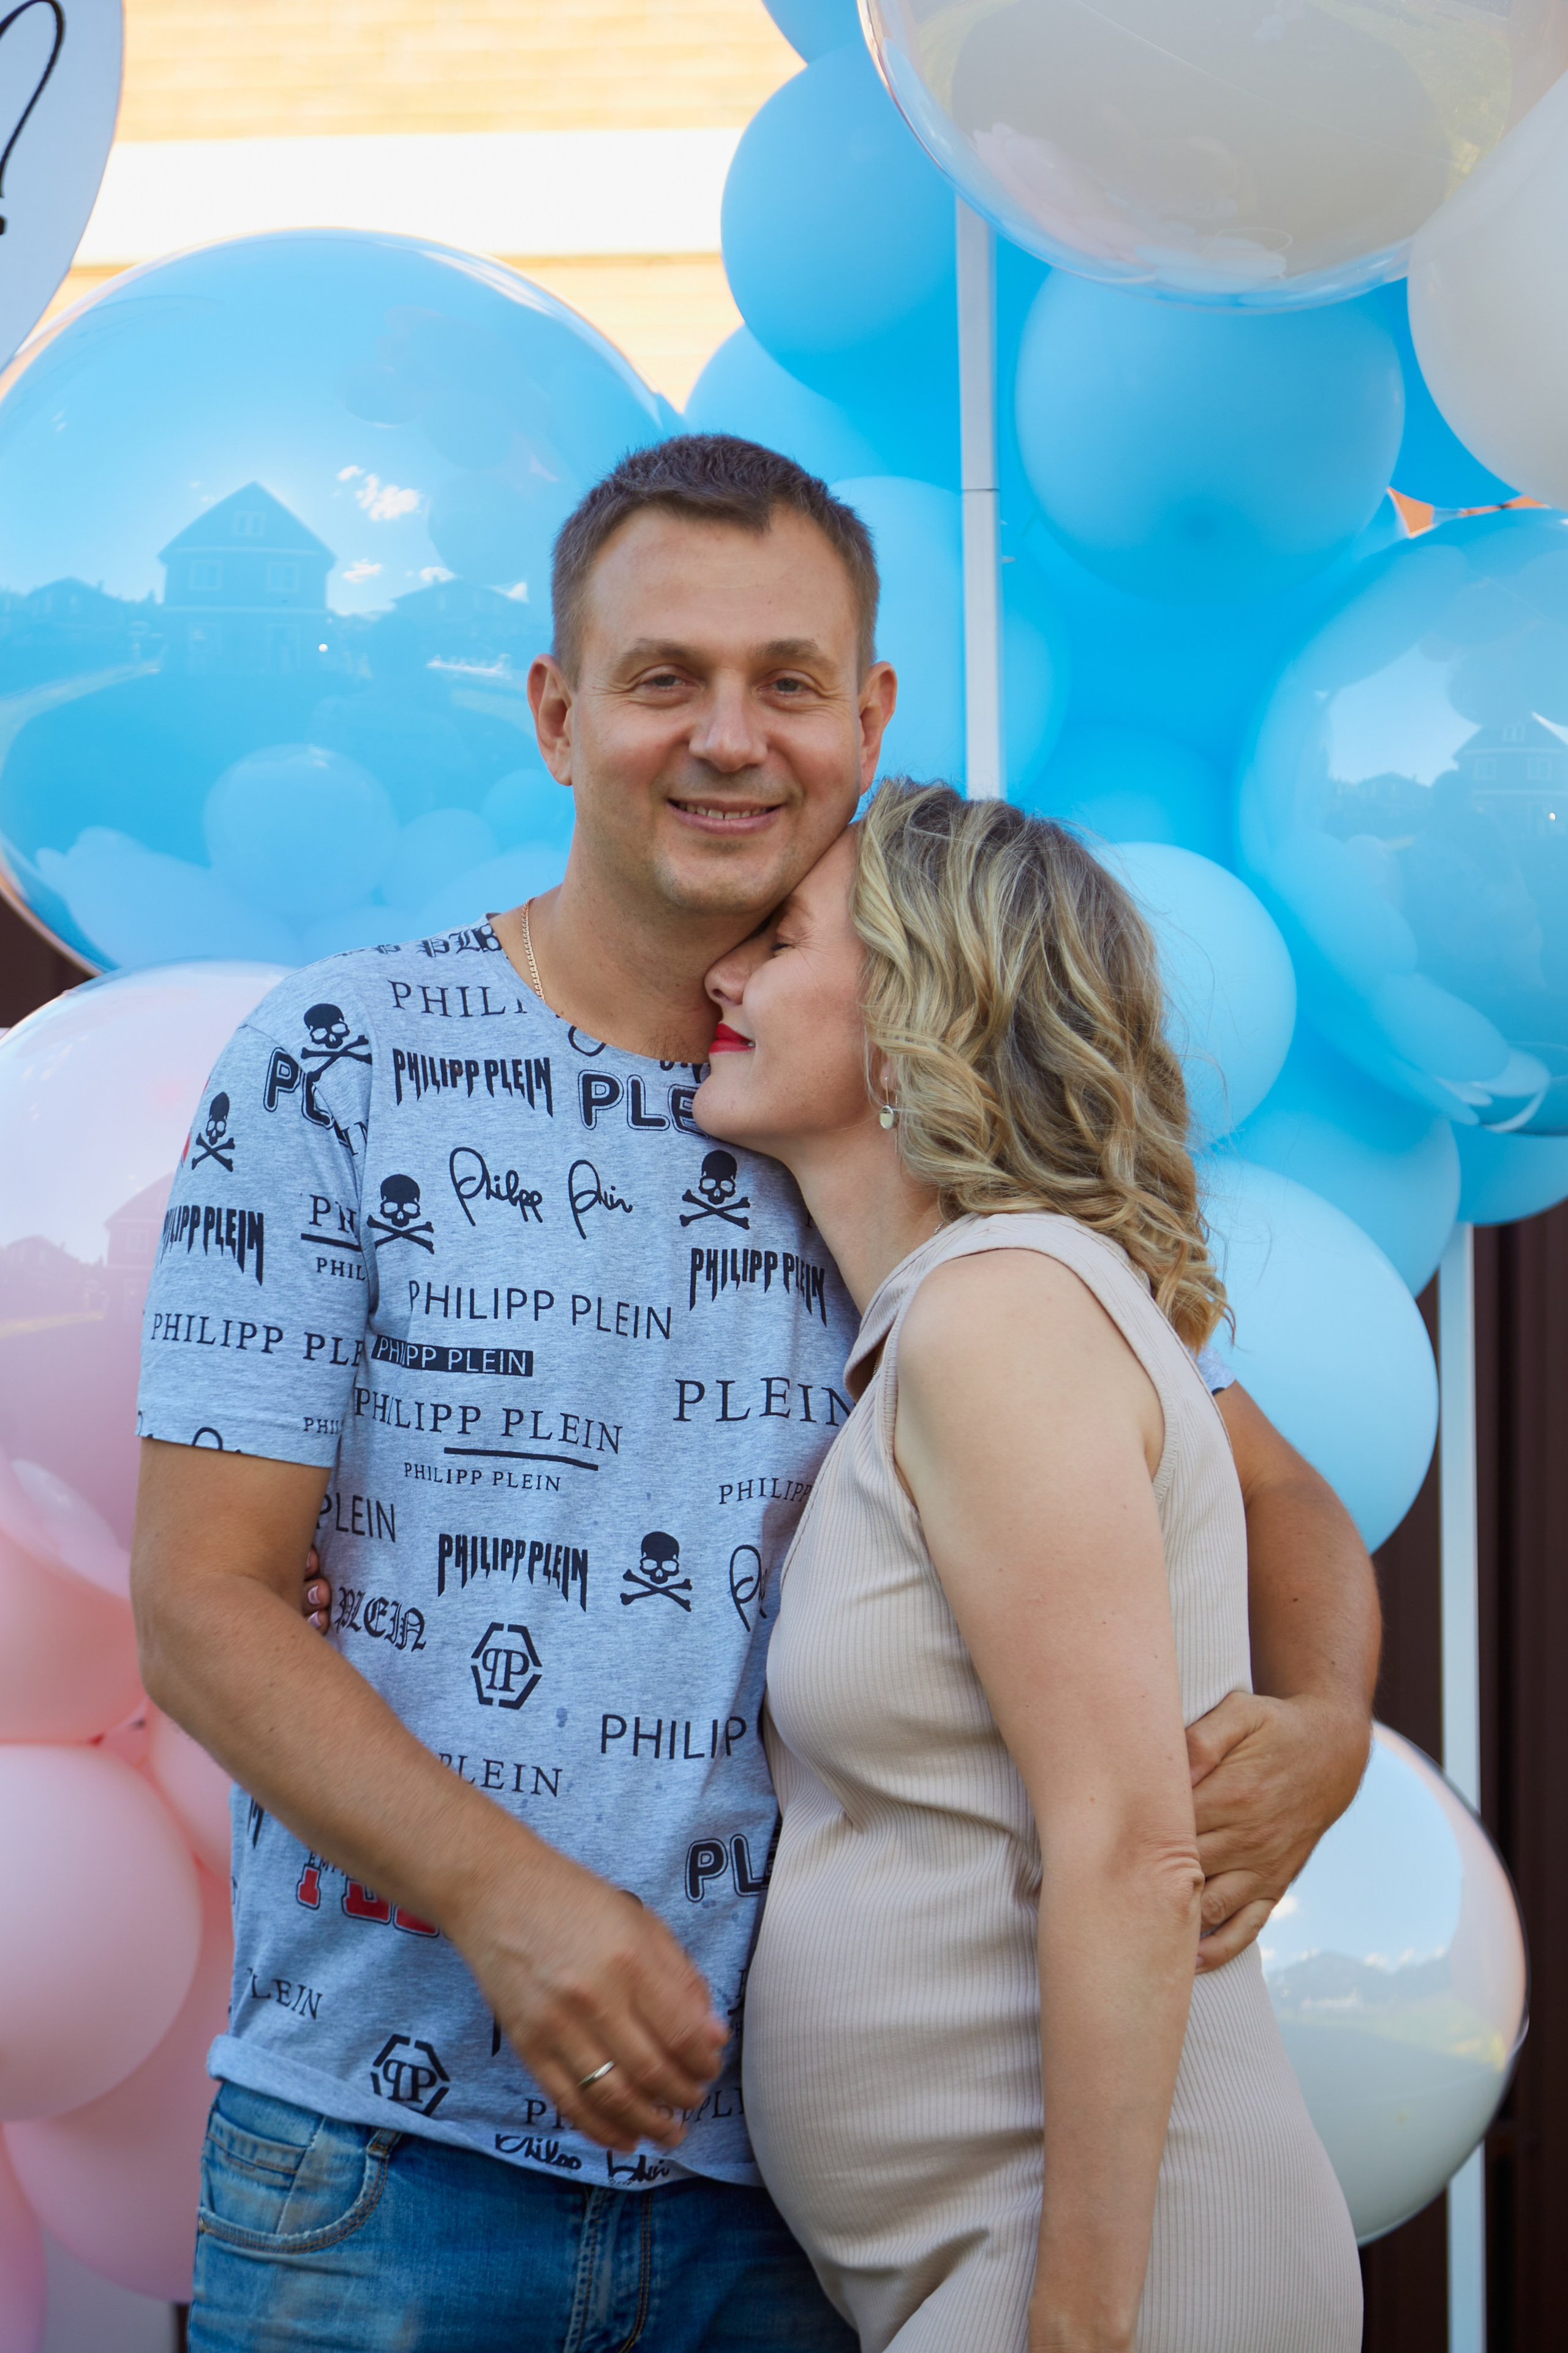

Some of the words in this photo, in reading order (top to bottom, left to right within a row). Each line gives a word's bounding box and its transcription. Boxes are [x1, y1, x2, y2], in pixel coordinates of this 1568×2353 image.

[393, 1048, 480, 1106] PHILIPP
[484, 1057, 553, 1118] PLEIN
[203, 1206, 264, 1286] PLEIN
[316, 1257, 366, 1281] PHIL
[409, 1280, 554, 1321] PHILIPP
[572, 1294, 671, 1340] PLEIN
[690, 1247, 778, 1312] PHILIPP
[783, 1252, 827, 1328] PLEIN
[151, 1313, 283, 1354] PHILIPP
[448, 1349, 526, 1374] PLEIN
[501, 1408, 623, 1454] PLEIN
[404, 1462, 483, 1485] PHILIPP
[492, 1471, 561, 1492] PLEIN
[437, 1533, 526, 1598] PHILIPP
[527, 1541, 588, 1612] PLEIN
[601, 1713, 747, 1760] PHILIP
[247, 1967, 323, 2020] LEIN
